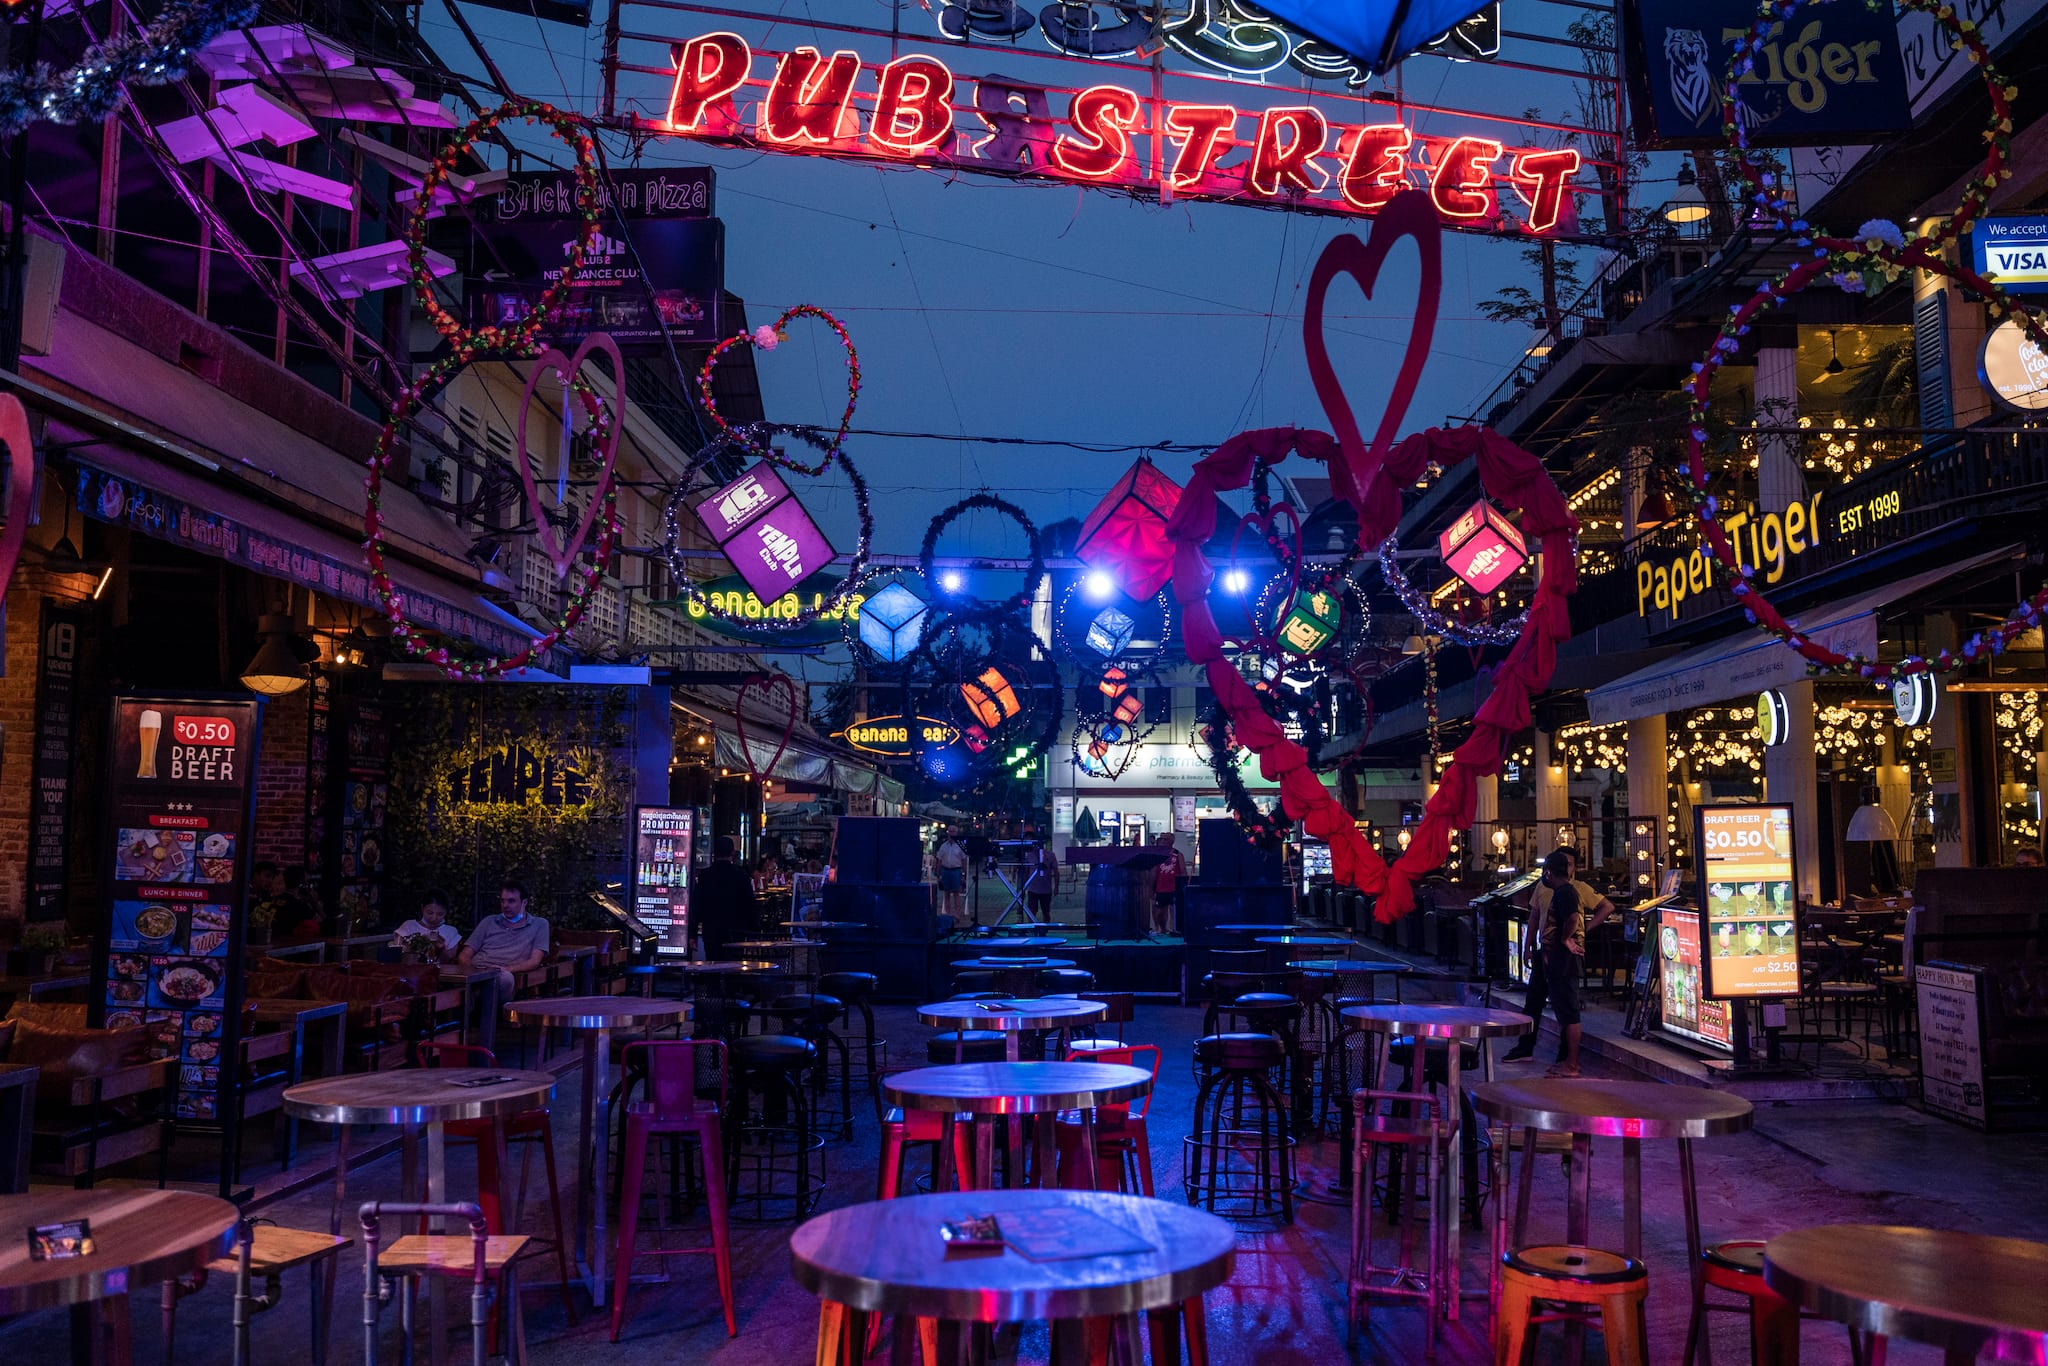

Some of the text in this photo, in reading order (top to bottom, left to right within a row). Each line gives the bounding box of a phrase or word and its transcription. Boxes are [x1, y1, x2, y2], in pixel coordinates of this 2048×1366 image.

[1722, 20, 1881, 113] Tiger
[666, 31, 954, 149] PUB
[1053, 85, 1580, 232] STREET
[497, 179, 570, 219] Brick
[645, 176, 706, 214] pizza
[1989, 223, 2047, 238] We accept
[583, 255, 603, 264] LUB
[1995, 253, 2047, 270] VISA
[124, 497, 165, 523] pepsi
[1839, 490, 1900, 534] EST 1999
[248, 536, 290, 573] TEMPLE
[291, 553, 321, 583] CLUB
[757, 523, 803, 580] TEMPLE
[758, 547, 778, 572] Club
[1466, 543, 1507, 579] TEMPLE
[1637, 490, 1822, 620] Paper Tiger
[815, 593, 866, 620] Lea
[47, 623, 76, 660] 18
[177, 721, 230, 741] $0.50
[850, 727, 908, 743] Banana
[172, 746, 236, 763] DRAFT
[171, 761, 234, 780] BEER
[448, 744, 591, 806] TEMPLE
[40, 778, 67, 790] THANK
[43, 791, 63, 804] YOU!
[160, 818, 199, 826] BREAKFAST
[641, 820, 690, 830] PROMOTION
[1704, 815, 1760, 824] DRAFT BEER
[1705, 830, 1762, 850] $0.50
[144, 889, 169, 897] LUNCH
[178, 890, 203, 898] DINNER
[1767, 961, 1798, 974] $2.50
[1916, 968, 1936, 981] HAPPY
[1937, 969, 1955, 984] HOUR
